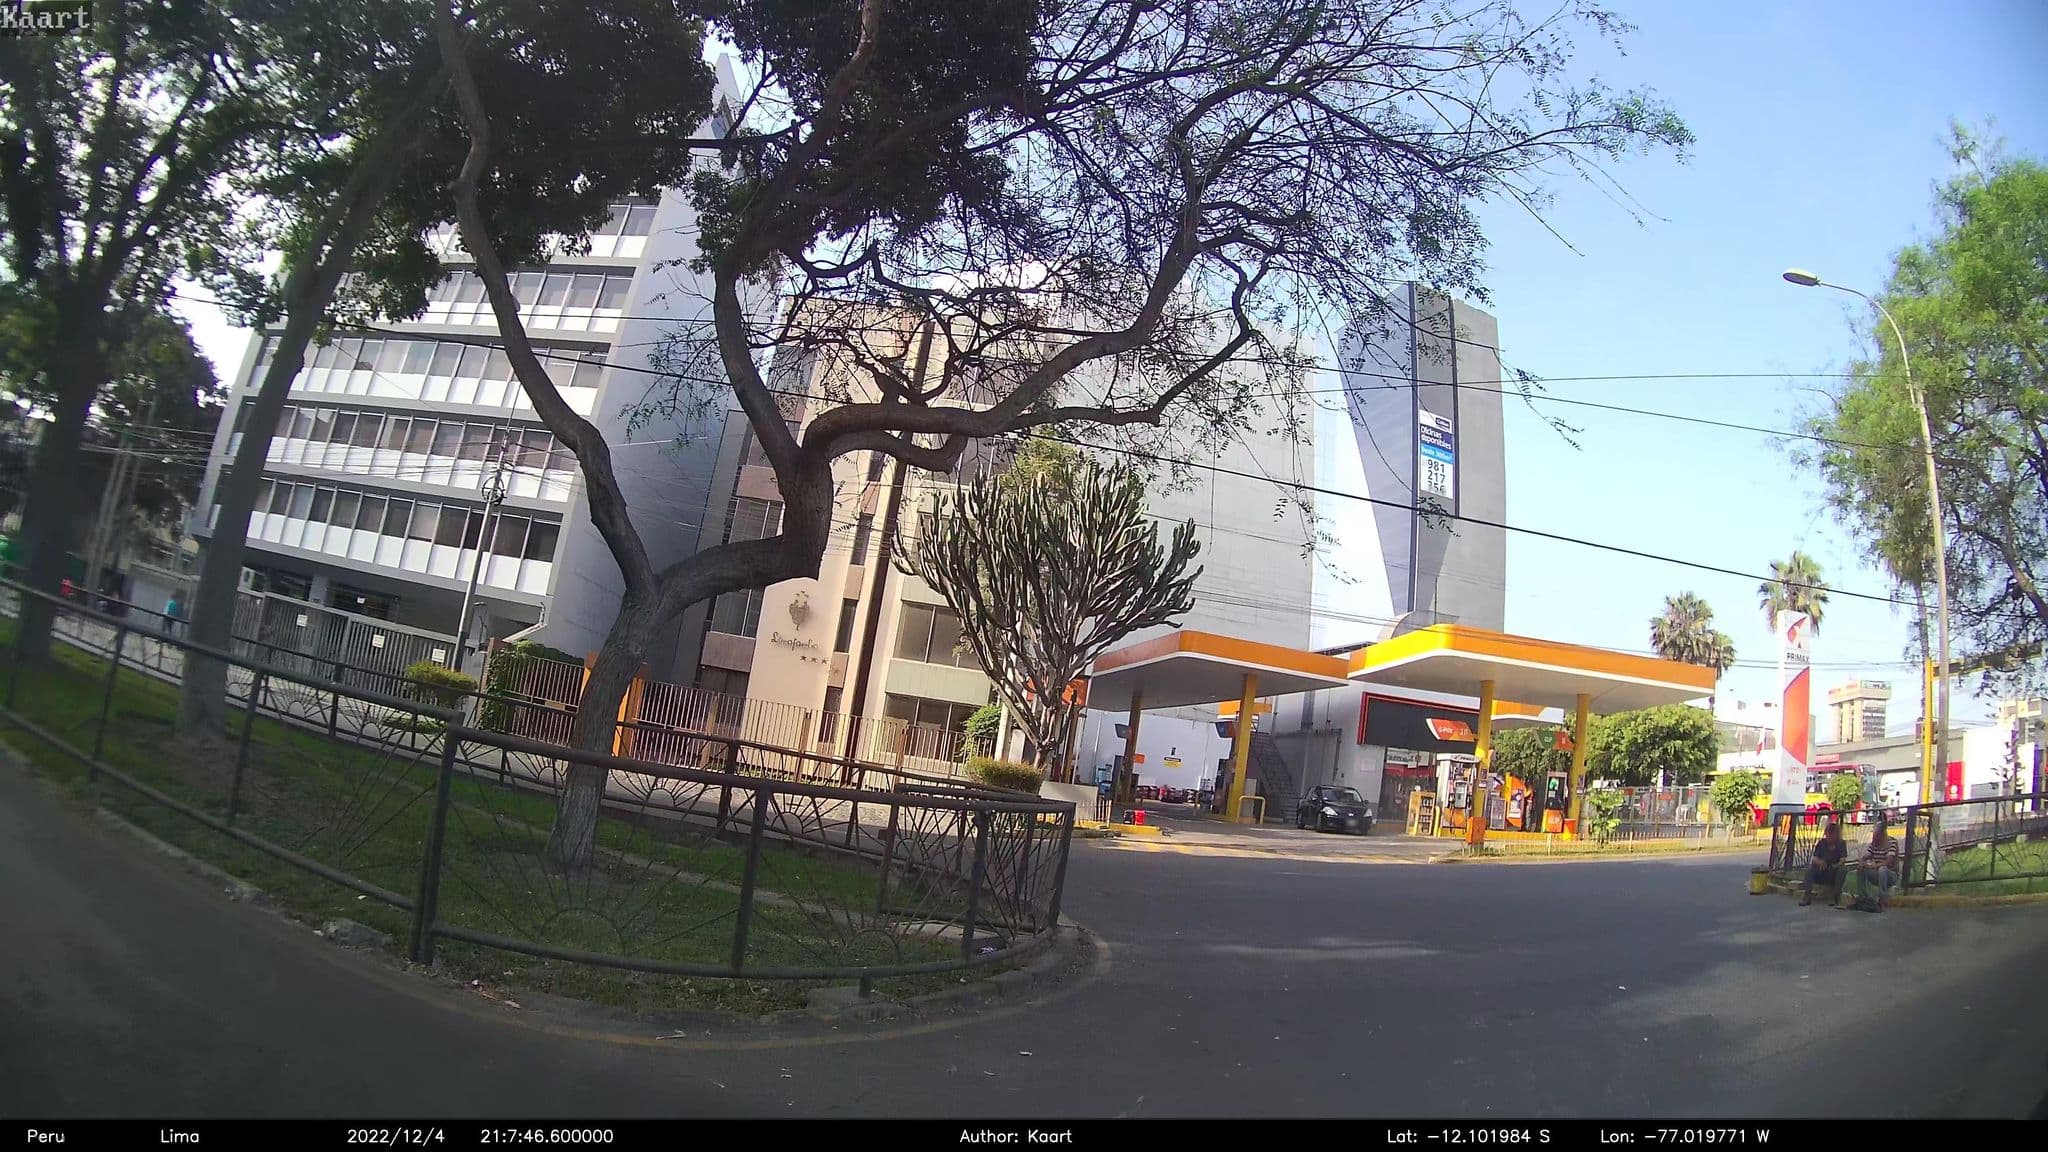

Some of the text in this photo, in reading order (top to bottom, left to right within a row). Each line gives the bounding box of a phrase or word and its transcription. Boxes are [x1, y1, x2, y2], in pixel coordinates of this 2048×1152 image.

[1428, 459, 1445, 473] 981
[1428, 470, 1445, 484] 217
[1786, 652, 1809, 662] PRIMAX
